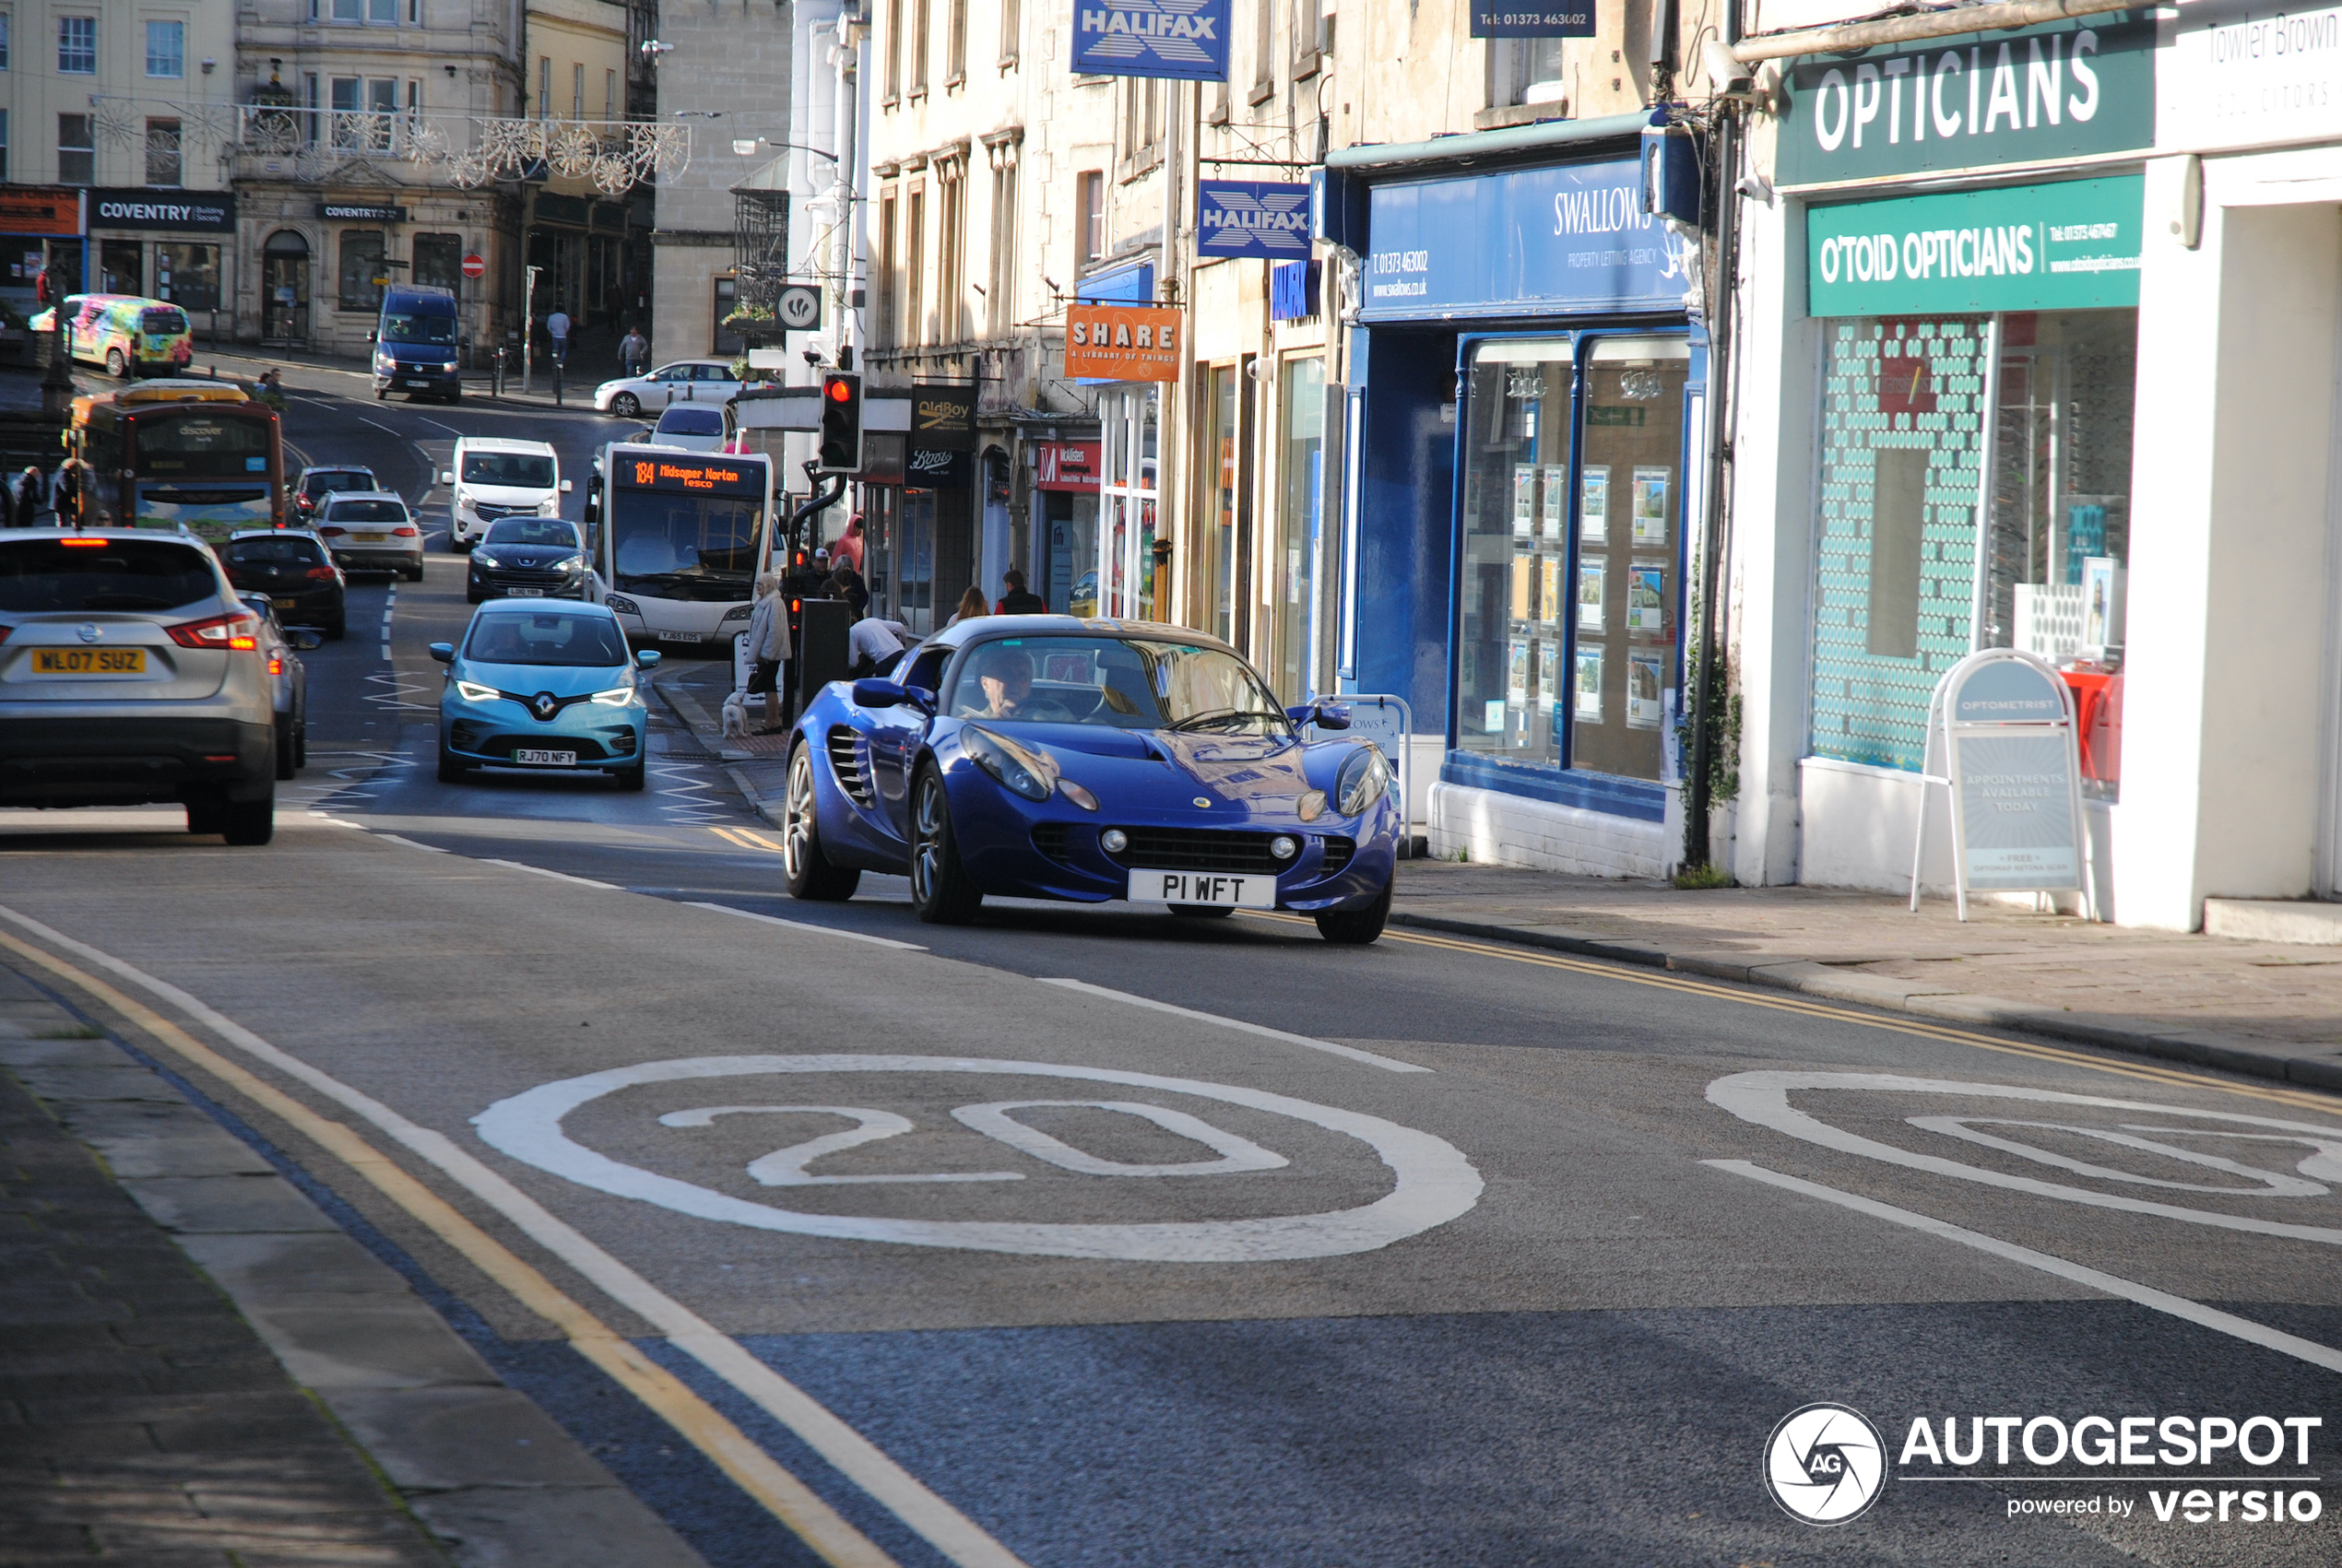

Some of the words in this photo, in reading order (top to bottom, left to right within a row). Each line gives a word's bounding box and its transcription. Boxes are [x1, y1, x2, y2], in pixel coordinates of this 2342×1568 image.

[1082, 9, 1217, 40] HALIFAX
[1480, 14, 1500, 25] Tel:
[1504, 14, 1540, 25] 01373
[1544, 14, 1586, 25] 463002
[2207, 11, 2268, 64] Towler
[2276, 12, 2337, 55] Brown
[1814, 29, 2101, 152] OPTICIANS
[100, 202, 192, 221] COVENTRY
[195, 206, 225, 217] Building
[325, 206, 377, 218] COVENTRY
[1202, 209, 1308, 230] HALIFAX
[1379, 252, 1401, 274] 01373
[1402, 250, 1428, 273] 463002
[1568, 252, 1599, 267] PROPERTY
[1601, 250, 1627, 266] LETTING
[1629, 248, 1658, 265] AGENCY
[1820, 232, 1898, 285] O'TOID
[1903, 223, 2034, 280] OPTICIANS
[1373, 277, 1427, 297] www.swallows.co.uk
[1072, 322, 1176, 350] SHARE
[1082, 351, 1120, 360] LIBRARY
[1125, 352, 1137, 360] OF
[1141, 353, 1176, 362] THINGS
[918, 401, 969, 419] OldBoy
[179, 425, 223, 435] discover
[909, 450, 953, 470] Boots
[634, 462, 656, 485] 184
[659, 465, 704, 480] Midsomer
[705, 467, 739, 482] Norton
[684, 477, 714, 489] Tesco
[662, 631, 681, 641] YJ65
[683, 632, 698, 642] EOS
[1962, 700, 2055, 711] OPTOMETRIST
[518, 750, 549, 763] RJ70
[551, 751, 574, 764] NFY
[1966, 773, 2065, 785] APPOINTMENTS
[1981, 786, 2051, 798] AVAILABLE
[1994, 801, 2038, 812] TODAY
[2006, 854, 2033, 863] FREE
[1196, 877, 1245, 902] WFT
[656, 1098, 1290, 1186] 20
